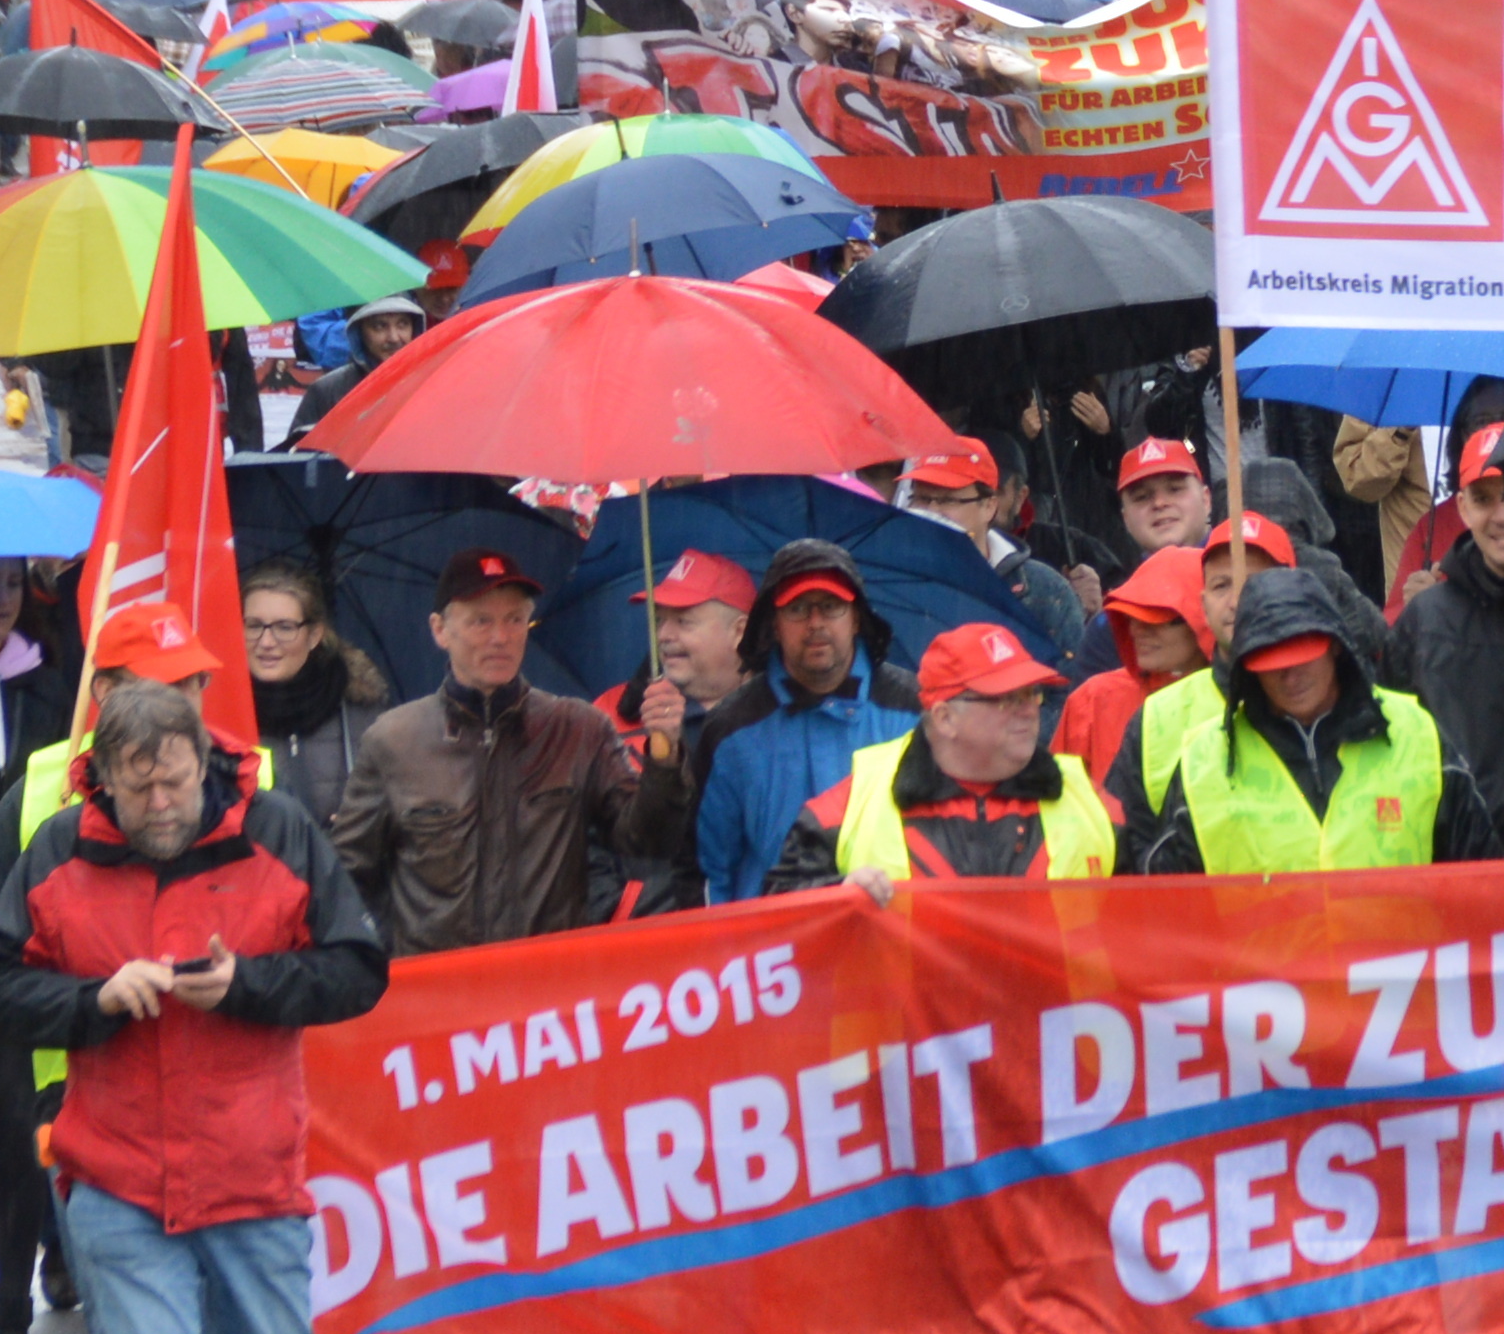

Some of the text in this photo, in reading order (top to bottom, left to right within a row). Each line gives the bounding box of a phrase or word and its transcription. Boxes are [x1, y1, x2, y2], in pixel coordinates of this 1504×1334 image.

[1040, 75, 1207, 113] FÜR ARBEI
[1044, 121, 1165, 149] ECHTEN
[1247, 269, 1384, 294] Arbeitskreis
[456, 997, 604, 1095] MAI
[618, 943, 804, 1053] 2015
[308, 1141, 508, 1320] DIE
[536, 1023, 996, 1258] ARBEIT
[1038, 979, 1309, 1144] DER
